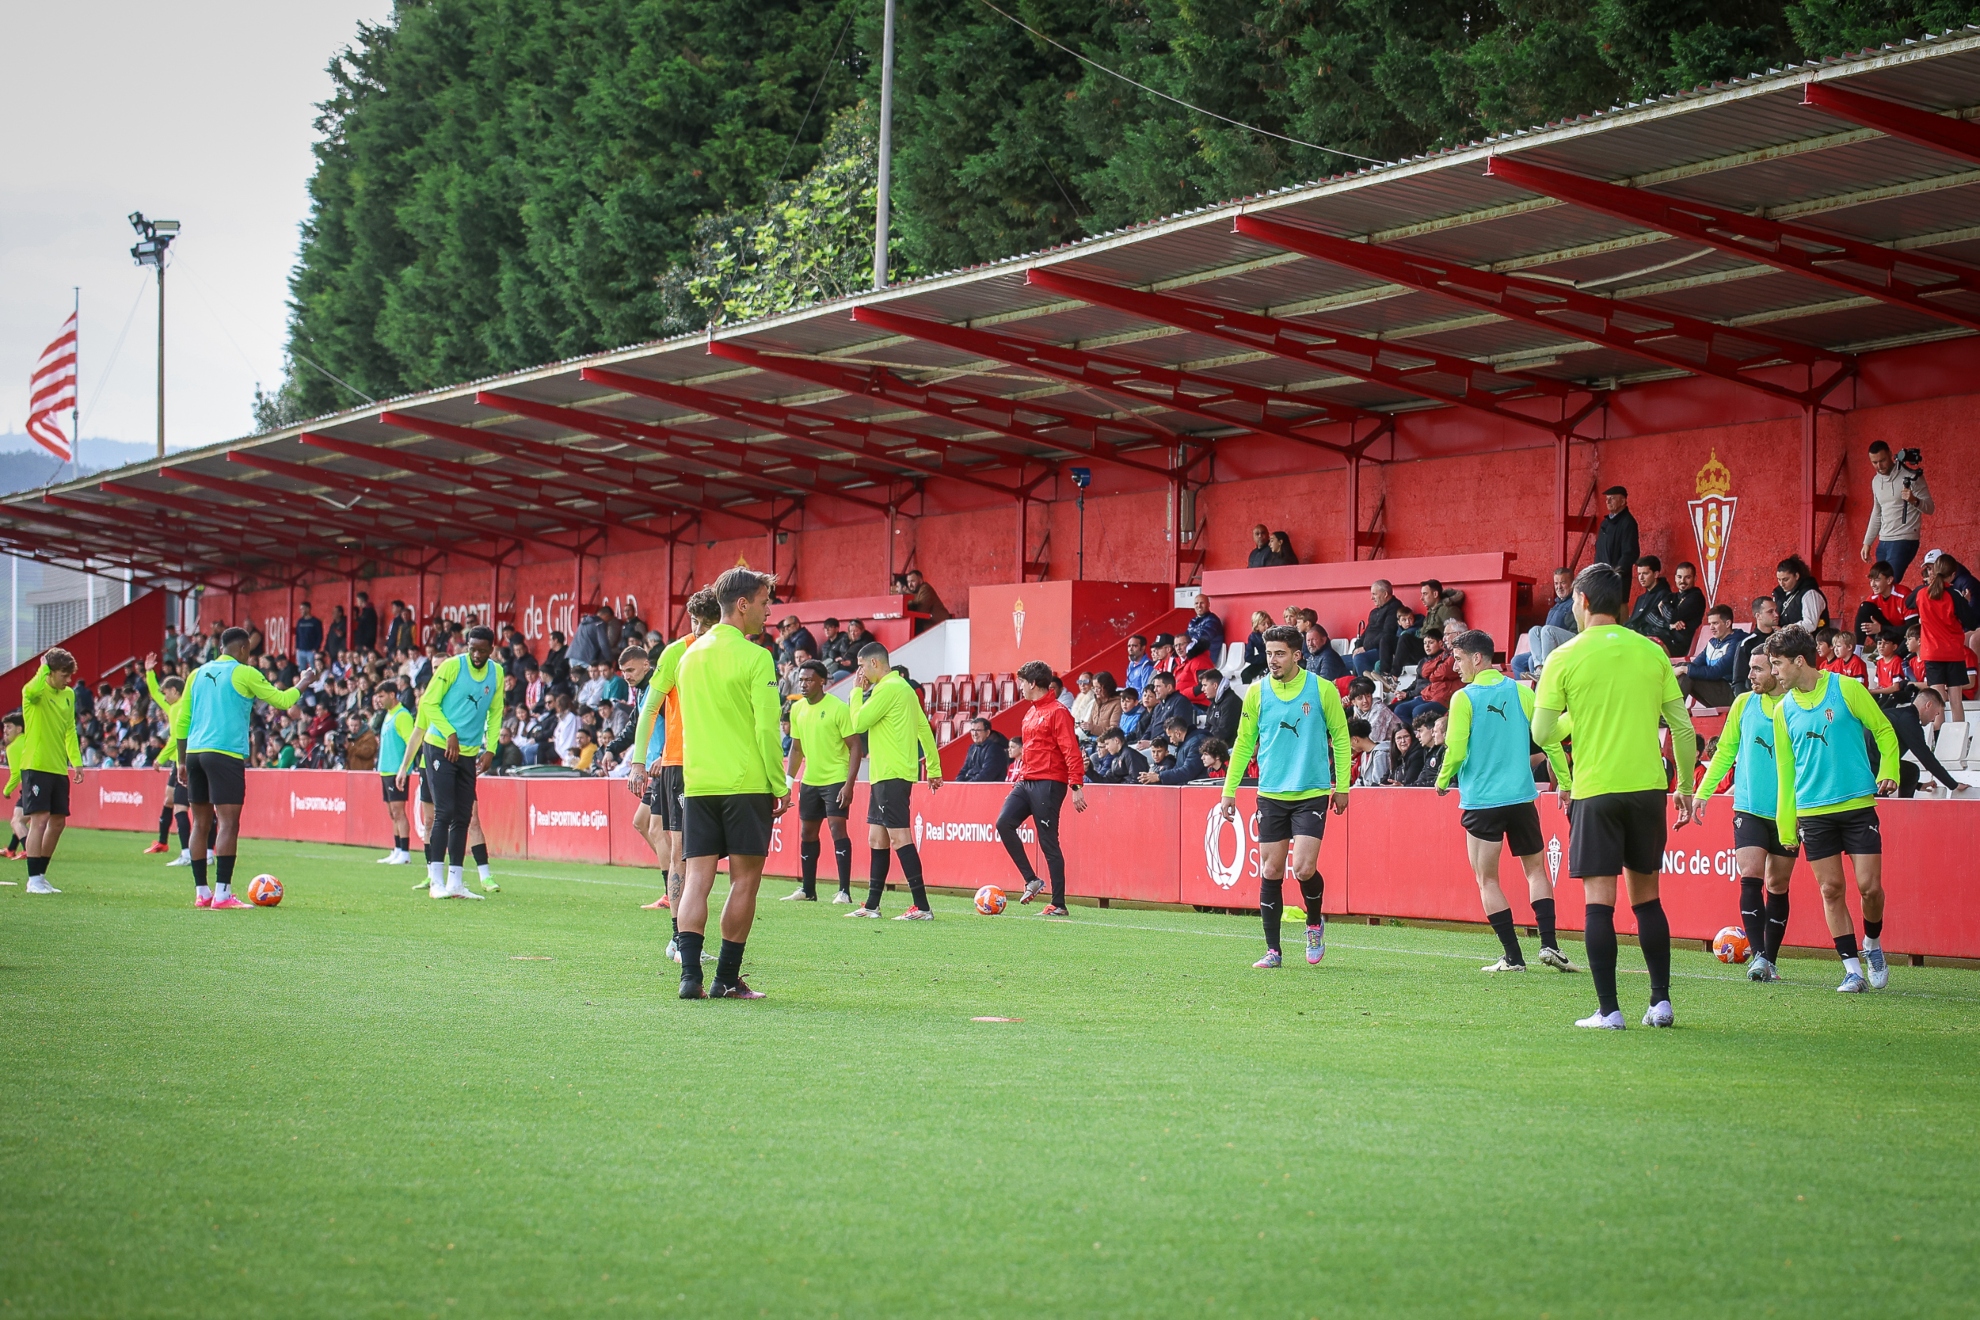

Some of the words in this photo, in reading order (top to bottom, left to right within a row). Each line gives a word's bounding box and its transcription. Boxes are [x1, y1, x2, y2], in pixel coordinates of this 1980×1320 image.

[524, 594, 543, 640] de
[550, 810, 581, 827] SPORTING
[926, 822, 945, 841] Real
[946, 823, 993, 843] SPORTING
[1689, 850, 1711, 875] de
